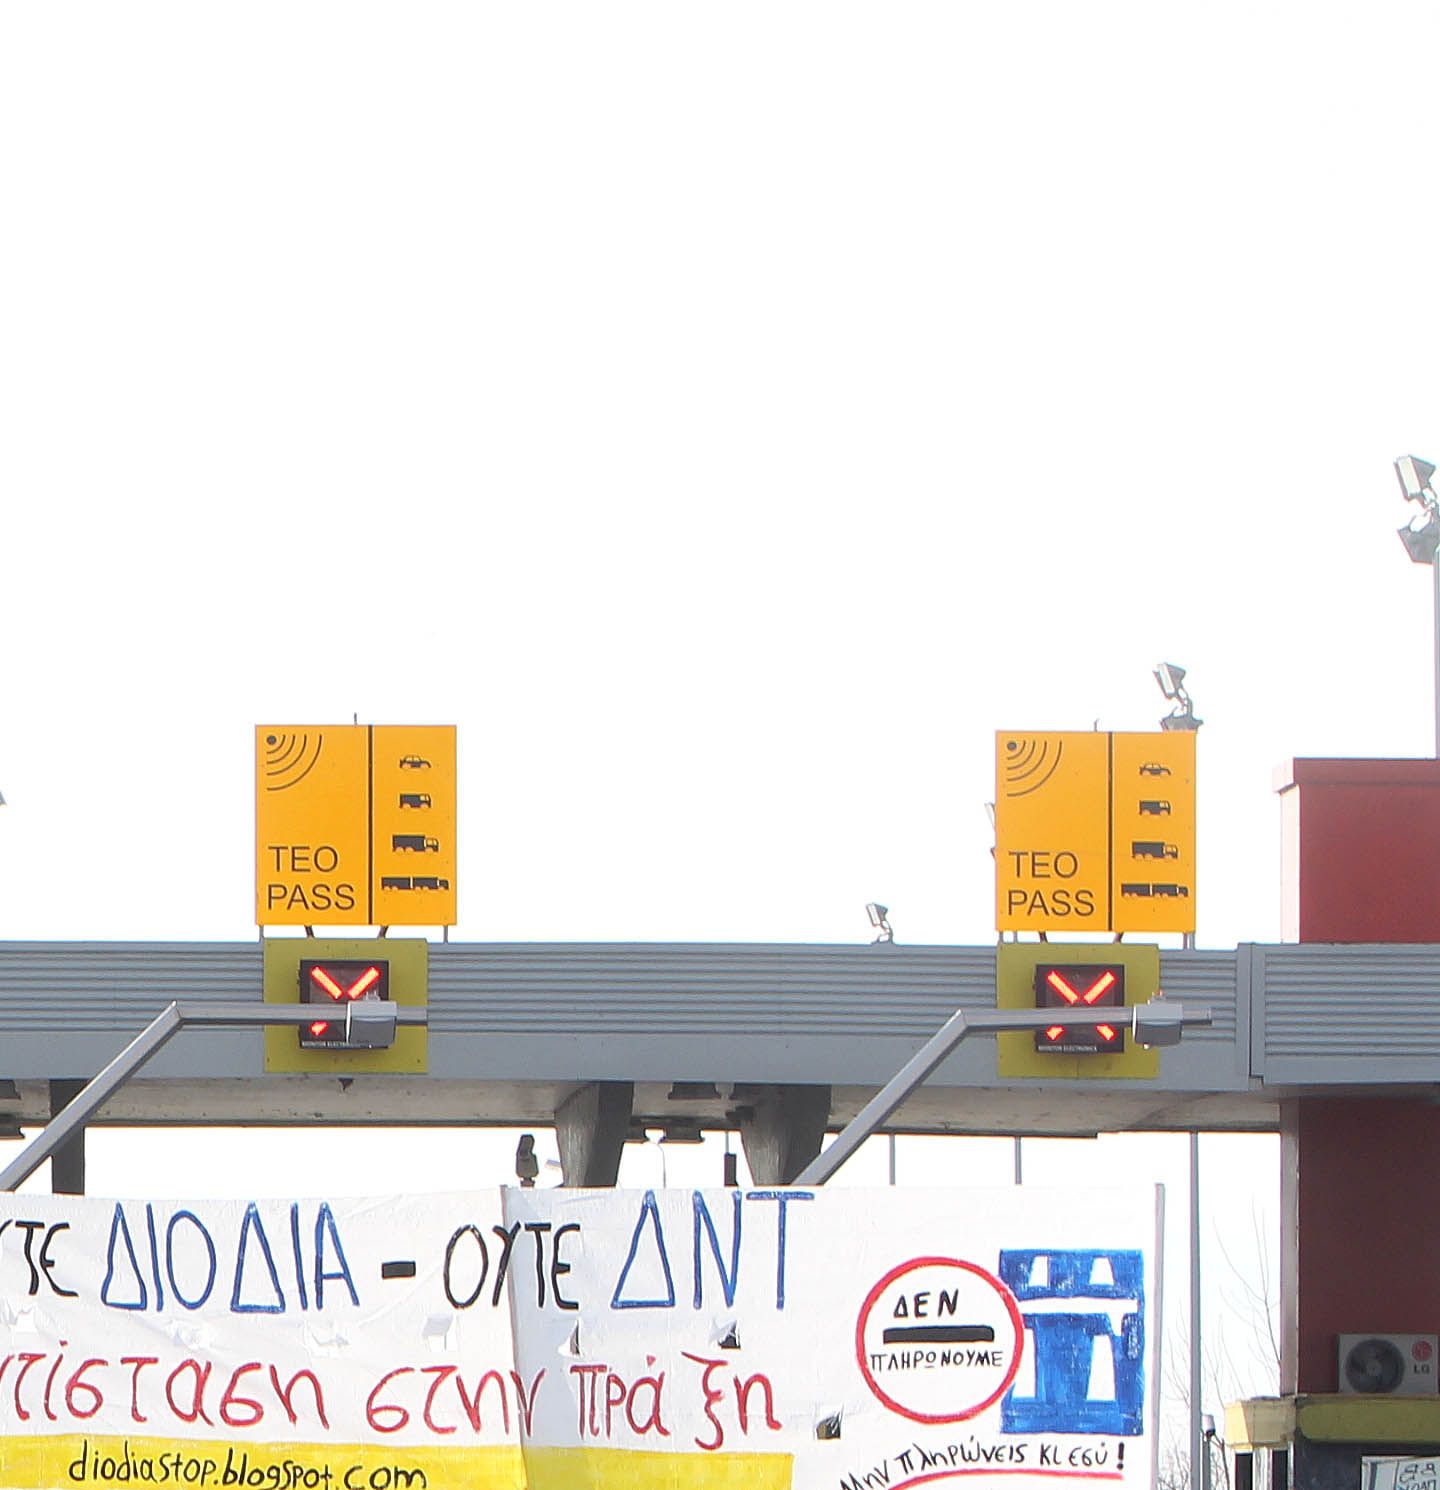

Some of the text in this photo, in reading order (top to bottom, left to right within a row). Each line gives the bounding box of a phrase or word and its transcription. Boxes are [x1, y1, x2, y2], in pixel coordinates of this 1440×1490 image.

[267, 845, 338, 873] TEO
[1008, 851, 1078, 878] TEO
[267, 883, 355, 911] PASS
[1007, 889, 1095, 917] PASS
[100, 1201, 360, 1314] ΔΙΟΔΙΑ
[443, 1220, 581, 1309] ΟΥΤΕ
[610, 1189, 816, 1311] ΔΝΤ
[893, 1288, 959, 1319] ΔΕΝ
[870, 1349, 1004, 1373] ΠΛΗΡΩΝΟΥΜΕ
[1413, 1364, 1431, 1375] LG
